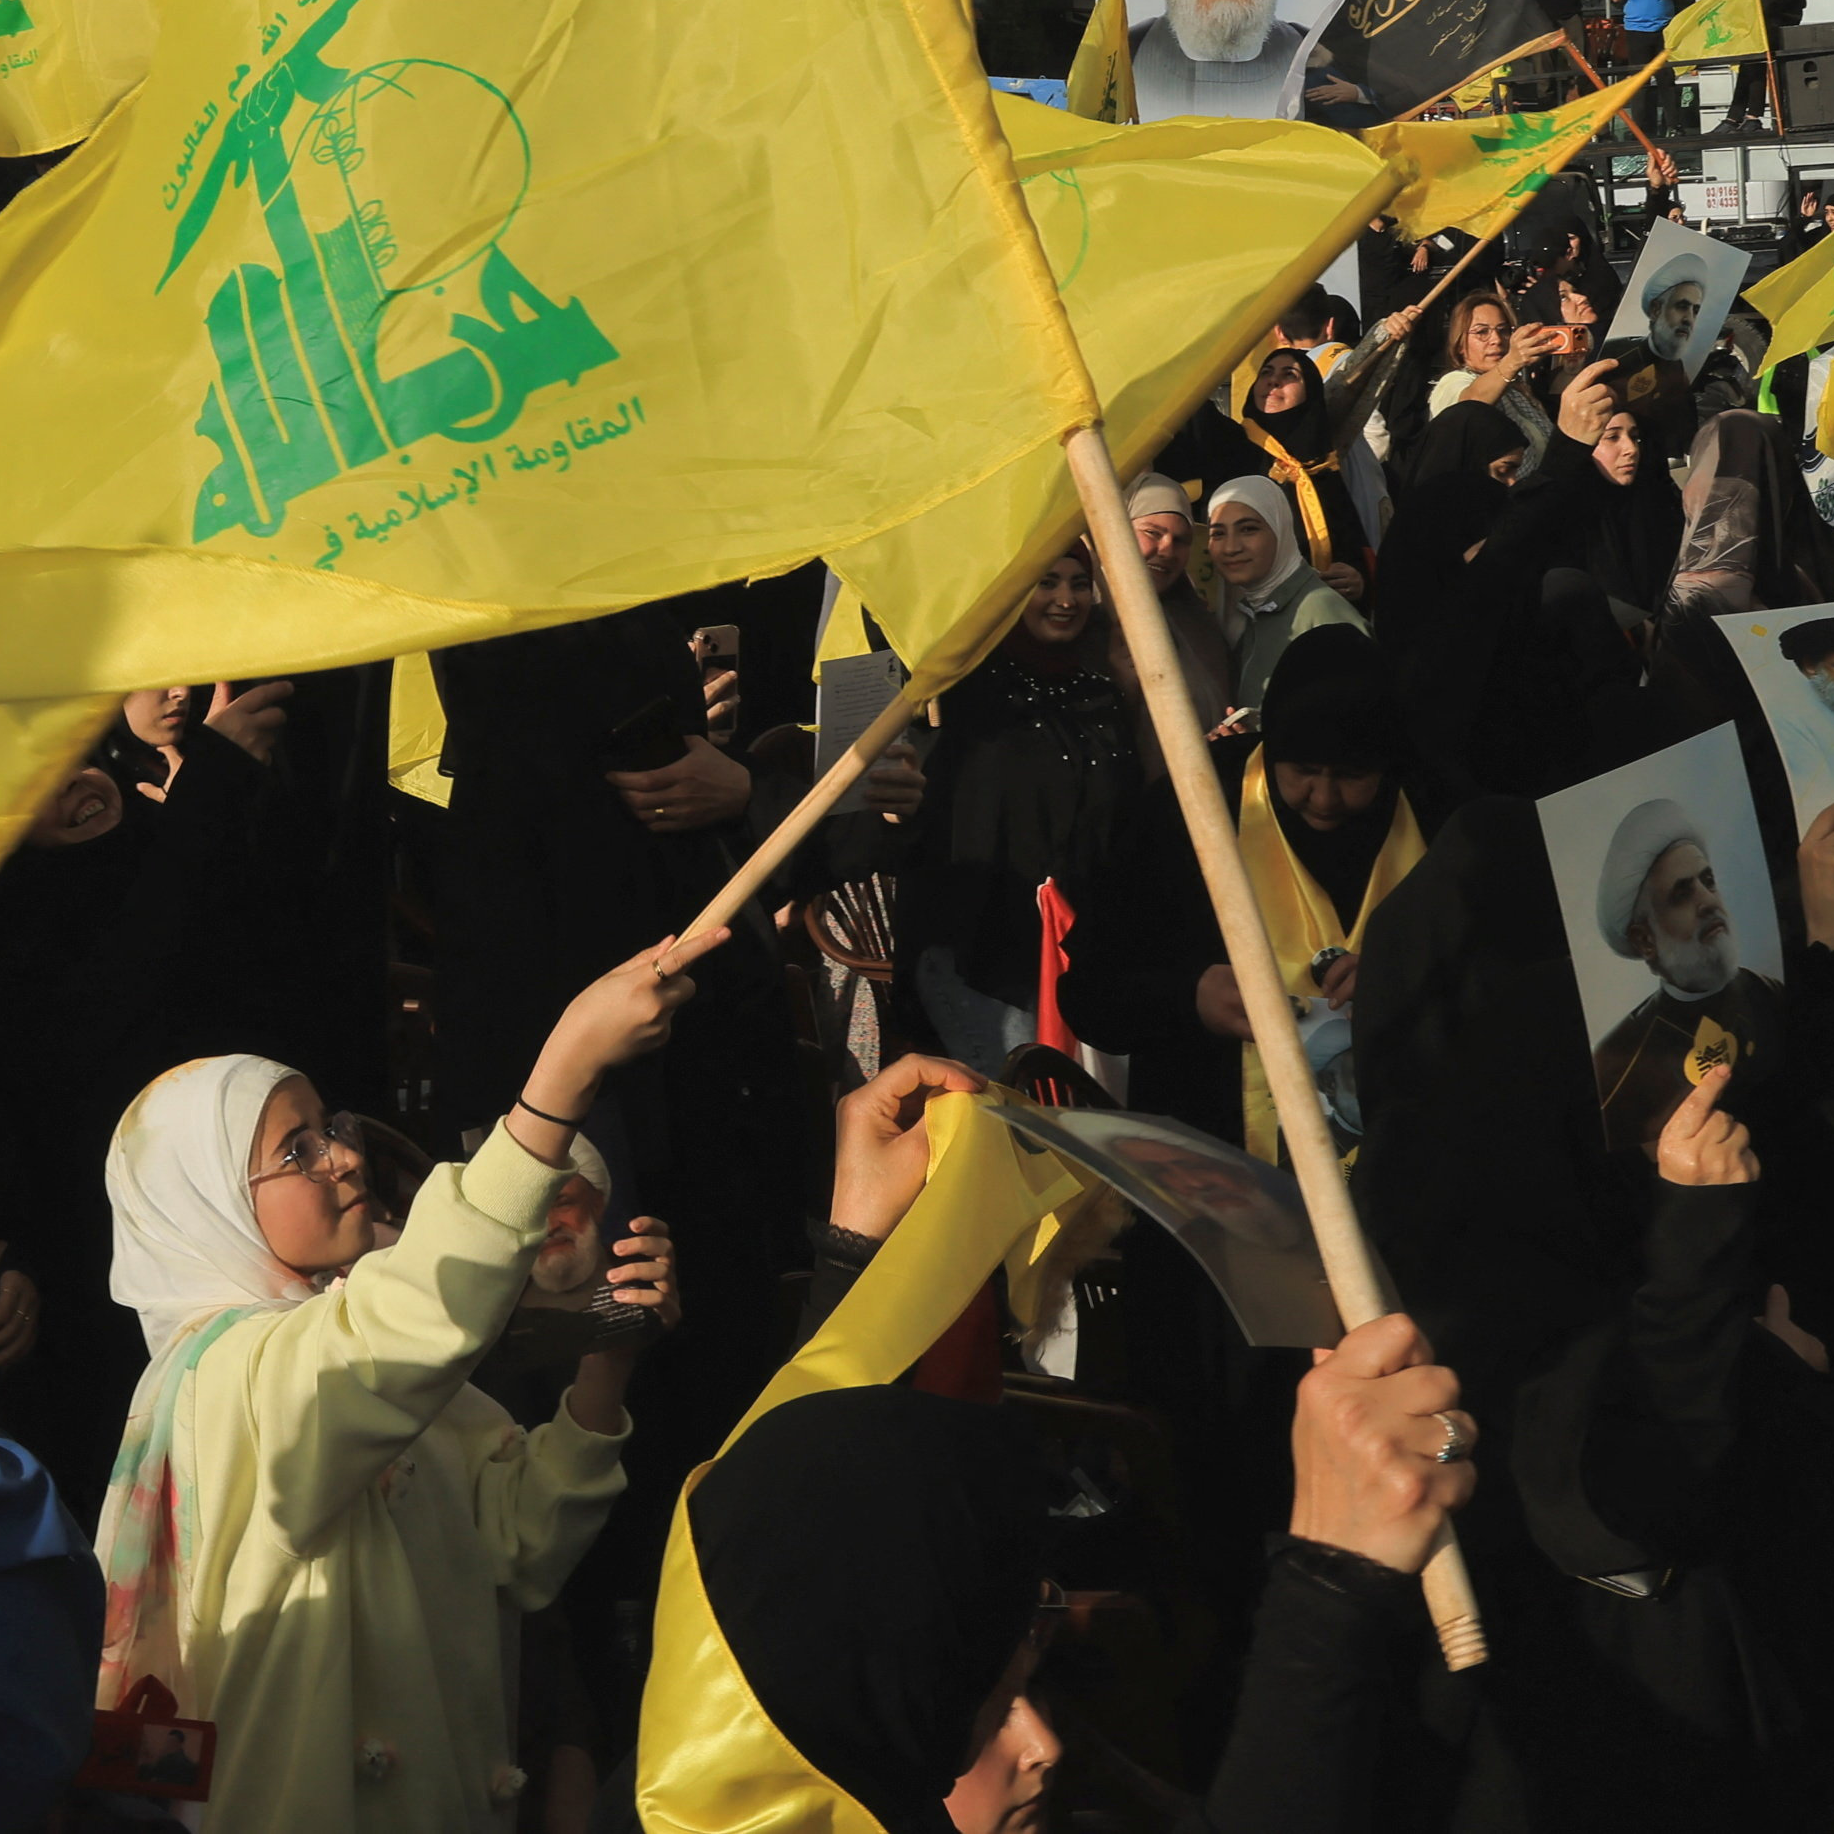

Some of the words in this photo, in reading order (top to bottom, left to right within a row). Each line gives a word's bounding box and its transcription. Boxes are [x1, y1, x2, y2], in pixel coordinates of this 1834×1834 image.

[257, 12, 288, 56] الله
[228, 64, 251, 103] هم
[162, 101, 219, 211] الغالبون
[504, 396, 647, 474] المقاومة
[346, 452, 498, 543] الإسلامية
